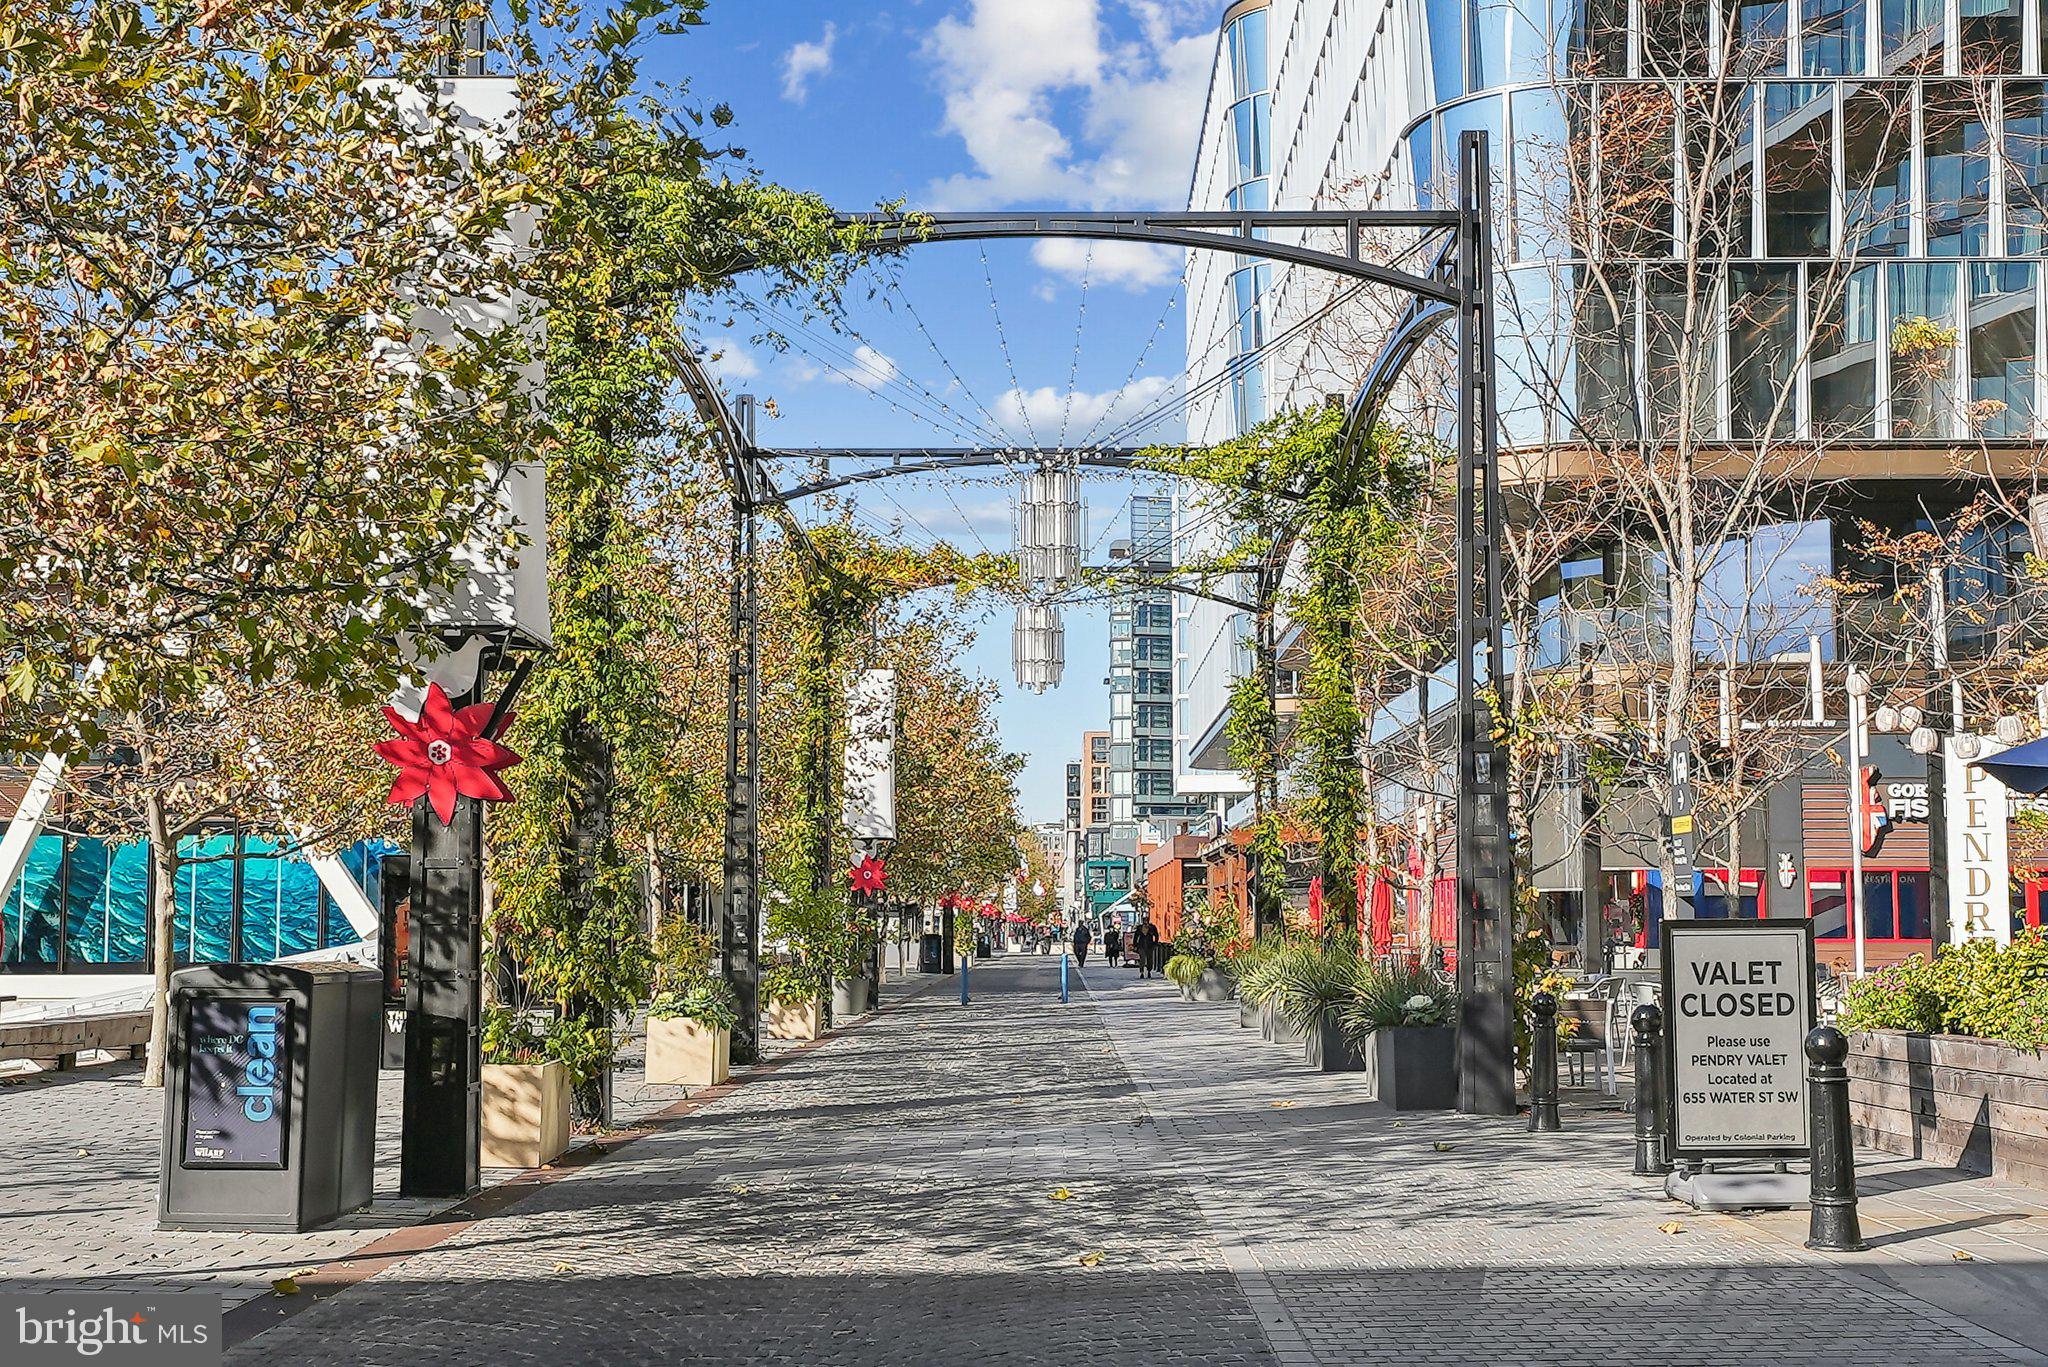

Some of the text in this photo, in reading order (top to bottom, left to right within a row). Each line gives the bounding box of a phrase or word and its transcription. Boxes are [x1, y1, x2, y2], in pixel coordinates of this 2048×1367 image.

[1887, 783, 1929, 798] GOR
[1888, 798, 1929, 818] FIS
[1963, 764, 1995, 940] PENDR
[1691, 961, 1782, 985] VALET
[1680, 992, 1795, 1017] CLOSED
[229, 1034, 244, 1044] DC
[1707, 1036, 1771, 1048] Please use
[236, 1005, 276, 1122] clean
[1691, 1054, 1788, 1067] PENDRY VALET
[1707, 1073, 1773, 1085] Located at
[1683, 1091, 1798, 1104] 655 WATER ST SW
[1685, 1133, 1796, 1143] Operated by Colonial Parking
